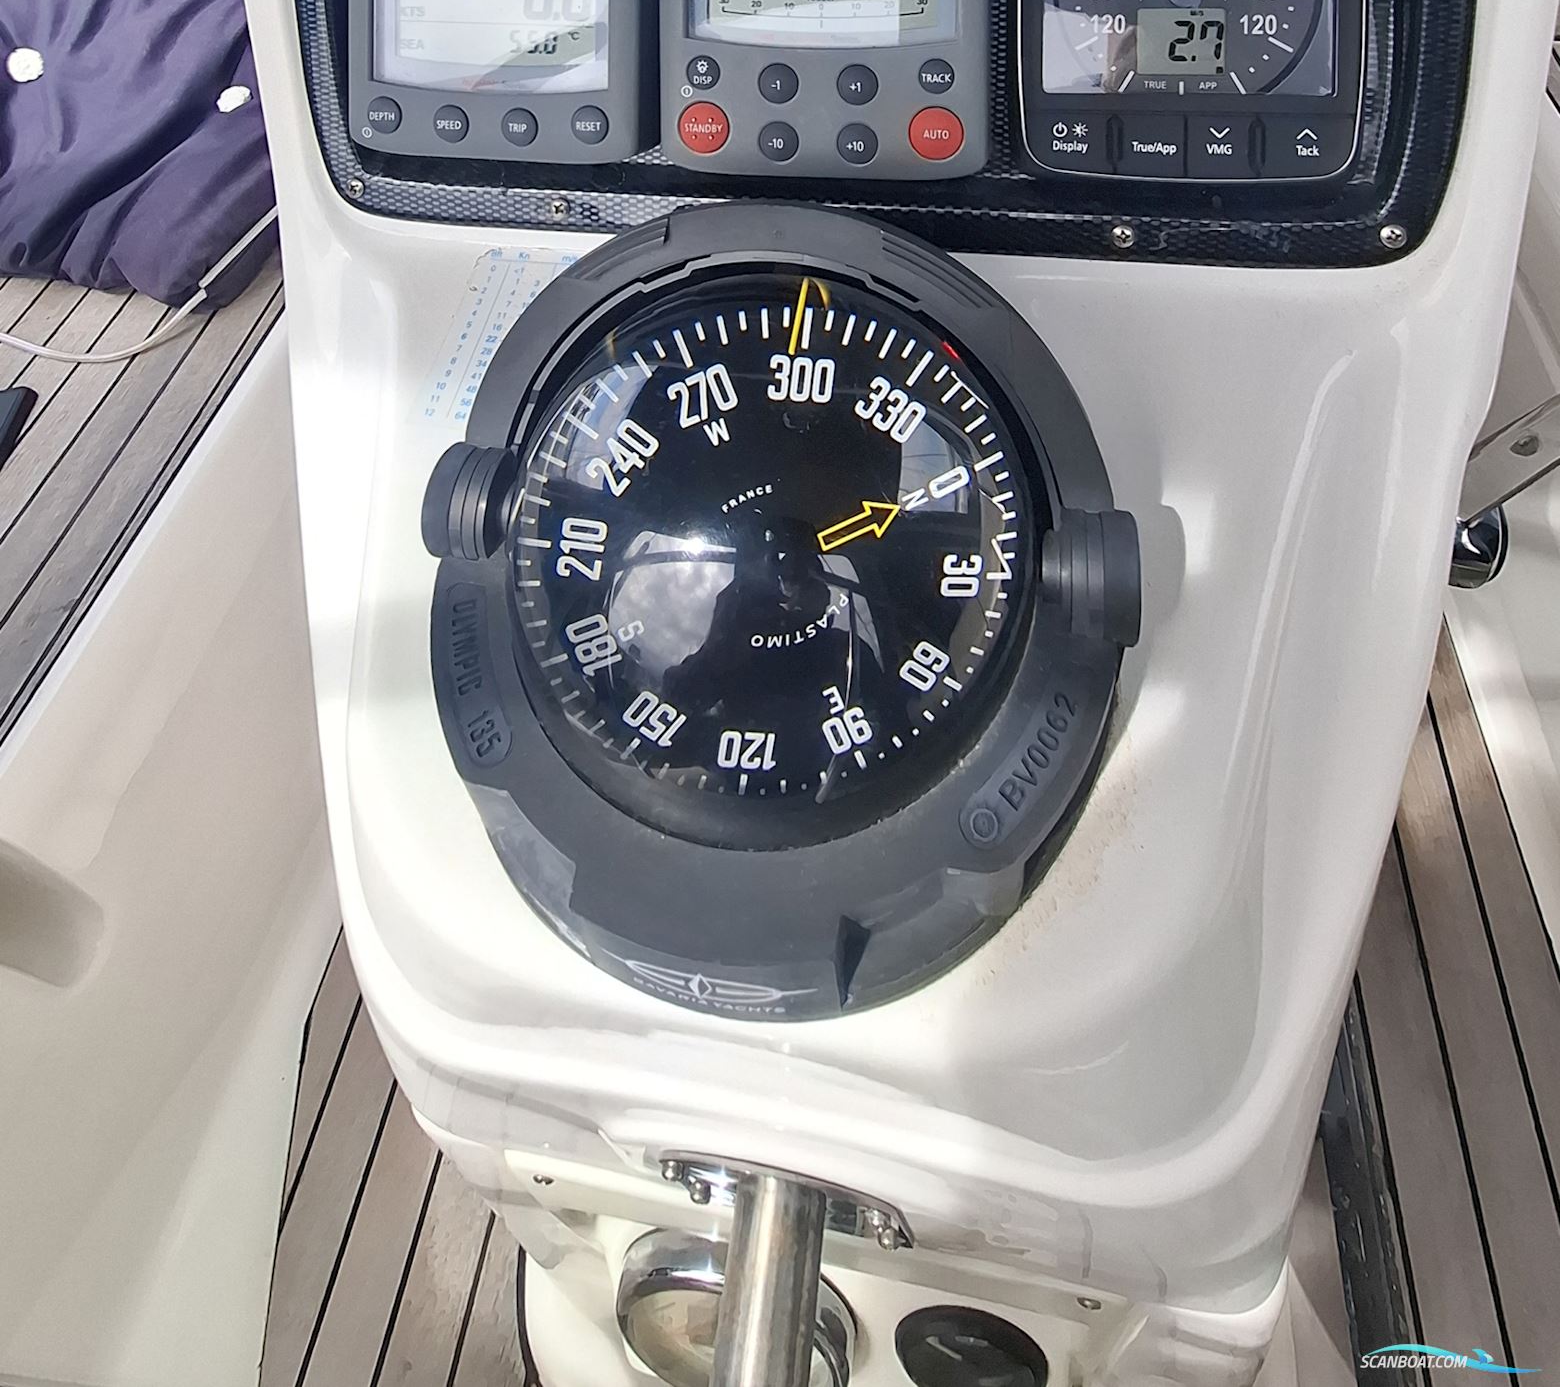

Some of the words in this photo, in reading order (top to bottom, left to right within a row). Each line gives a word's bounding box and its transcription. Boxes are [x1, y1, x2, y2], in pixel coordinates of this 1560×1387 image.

[751, 0, 762, 8] 20
[784, 2, 795, 10] 10
[1090, 13, 1126, 36] 120
[1239, 13, 1278, 37] 120
[1168, 20, 1225, 62] 2.7
[692, 74, 713, 86] DISP
[770, 80, 782, 92] -1
[848, 81, 863, 93] +1
[921, 73, 952, 84] TRACK
[1143, 79, 1168, 90] TRUE
[1198, 79, 1218, 90] APP
[369, 110, 395, 122] DEPTH
[436, 119, 462, 131] SPEED
[575, 121, 602, 132] RESET
[508, 122, 528, 134] TRIP
[684, 122, 723, 135] STANDBY
[923, 129, 950, 141] AUTO
[767, 138, 785, 151] -10
[845, 140, 865, 154] +10
[1052, 141, 1089, 153] Display
[1132, 141, 1178, 155] True/App
[1206, 144, 1233, 155] VMG
[1296, 145, 1320, 156] Tack
[485, 334, 499, 344] 22
[436, 381, 447, 391] 10
[766, 354, 836, 404] 300
[667, 363, 739, 429] 270
[424, 407, 436, 417] 12
[854, 376, 927, 444] 330
[703, 417, 731, 447] W
[585, 418, 660, 498] 240
[928, 465, 970, 499] 0
[721, 484, 774, 514] FRANCE
[901, 487, 929, 511] N
[556, 517, 609, 582] 210
[940, 554, 983, 598] 30
[617, 619, 645, 643] S
[750, 593, 850, 648] PLASTIMO
[451, 598, 484, 697] OLYMPIC
[565, 613, 623, 678] 180
[899, 640, 951, 692] 60
[822, 685, 846, 715] E
[622, 690, 687, 748] 150
[821, 706, 873, 755] 90
[466, 710, 503, 759] 135
[716, 730, 778, 771] 120
[998, 691, 1077, 812] BV0062
[713, 1001, 786, 1014] YACHTS
